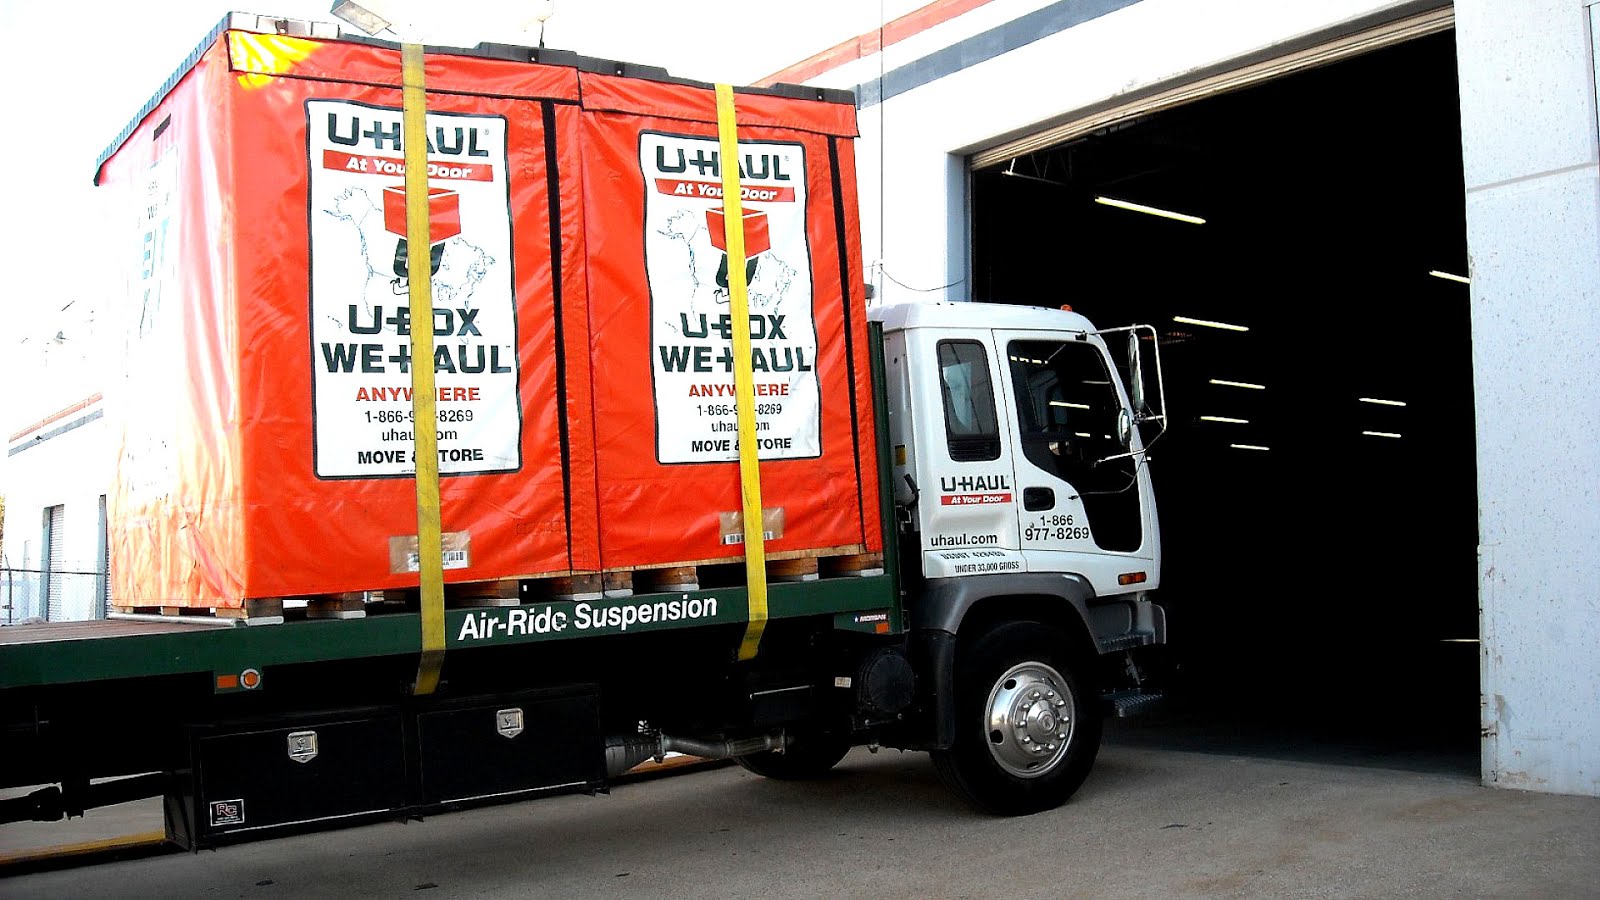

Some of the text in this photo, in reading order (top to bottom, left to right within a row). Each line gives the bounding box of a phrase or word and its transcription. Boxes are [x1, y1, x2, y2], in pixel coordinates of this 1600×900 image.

[328, 112, 489, 157] U-HUL
[346, 157, 368, 171] At
[374, 158, 406, 175] You
[656, 145, 791, 180] U-HUL
[674, 182, 694, 195] At
[697, 184, 723, 197] You
[355, 387, 481, 402] ANYWERE
[688, 384, 790, 398] ANYWERE
[364, 409, 474, 423] 1-866-9-8269
[696, 403, 783, 416] 1-866-9-8269
[711, 420, 770, 432] uhauom
[381, 428, 458, 441] uhauom
[691, 440, 730, 452] MOVE
[756, 437, 792, 450] TORE
[357, 450, 406, 464] MOVE
[438, 448, 484, 462] TORE
[940, 475, 1010, 492] U-HAUL
[950, 495, 1004, 504] At Your Door
[1040, 514, 1074, 527] 1-866
[930, 533, 998, 547] uhaul.com
[1024, 527, 1090, 541] 977-8269
[954, 561, 1020, 574] UNDER 33,000 GROSS
[457, 594, 718, 641] Air-Ride Suspension
